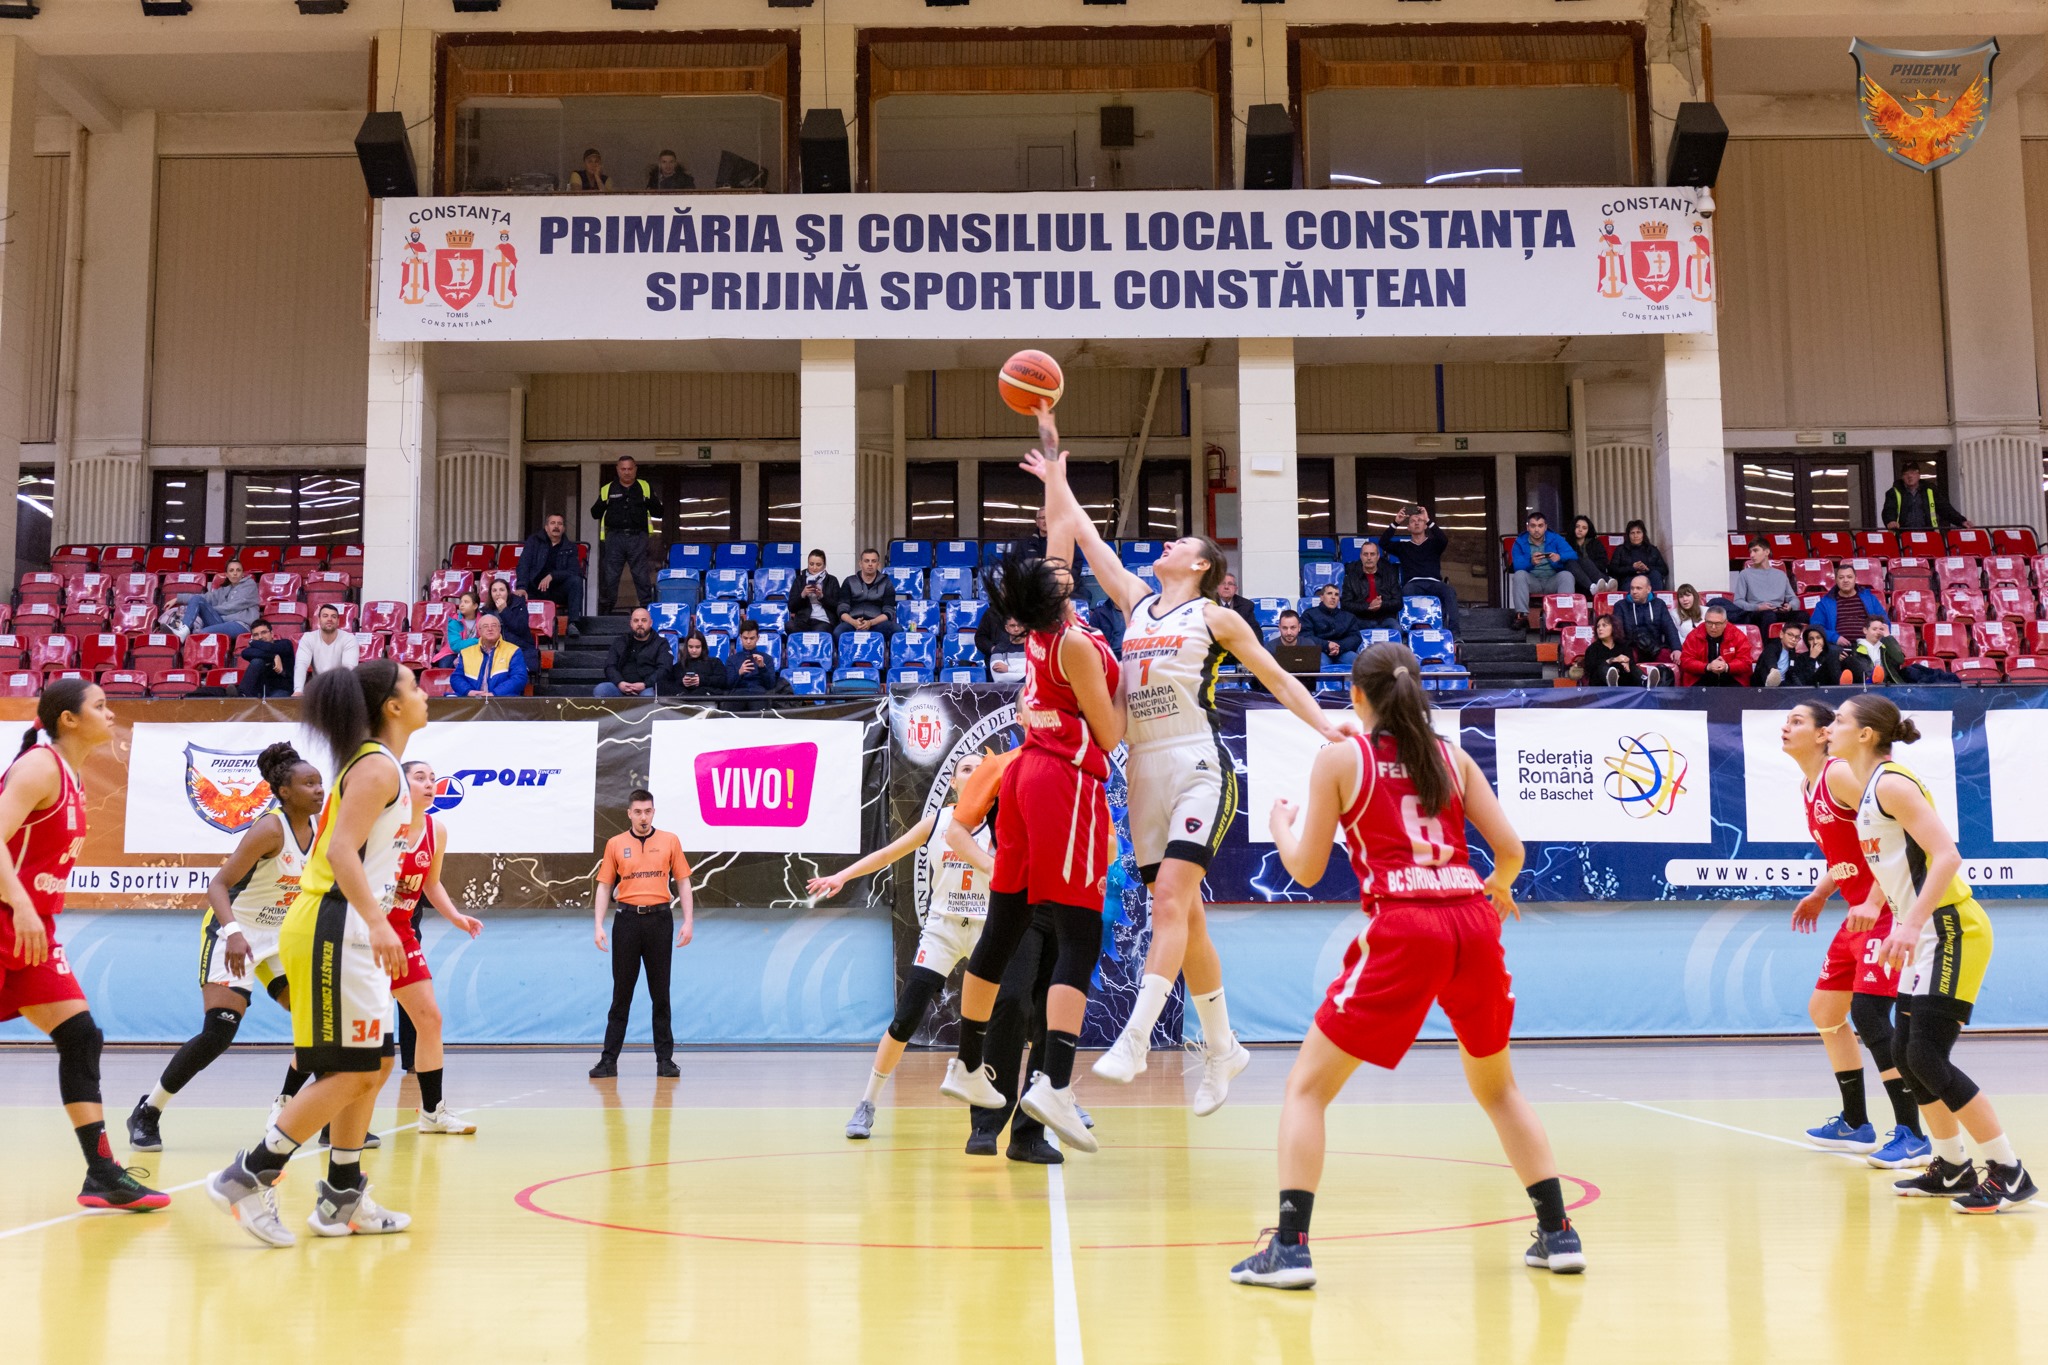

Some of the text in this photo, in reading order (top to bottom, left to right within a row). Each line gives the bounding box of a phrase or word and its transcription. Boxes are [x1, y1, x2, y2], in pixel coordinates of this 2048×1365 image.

[409, 205, 511, 225] CONSTANȚA
[540, 206, 783, 254] PRIMĂRIA
[859, 212, 1112, 253] CONSILIUL
[1126, 211, 1272, 251] LOCAL
[1286, 209, 1575, 260] CONSTANȚA
[646, 261, 1466, 320] SPRIJINĂ SPORTUL CONSTĂNȚEAN
[421, 318, 493, 328] CONSTANTIANA
[1622, 311, 1693, 320] CONSTANTIANA
[1140, 659, 1153, 687] 7
[988, 711, 1008, 732] DE
[1518, 749, 1593, 768] Federația
[1519, 766, 1594, 783] Română
[711, 767, 794, 809] VIVO!
[1519, 788, 1593, 800] de Baschet
[1401, 794, 1454, 866] 6
[71, 871, 100, 888] lub
[110, 871, 179, 892] Sportiv
[961, 870, 973, 891] 6
[1387, 870, 1404, 892] BC
[917, 950, 926, 964] 6
[352, 1019, 380, 1042] 34
